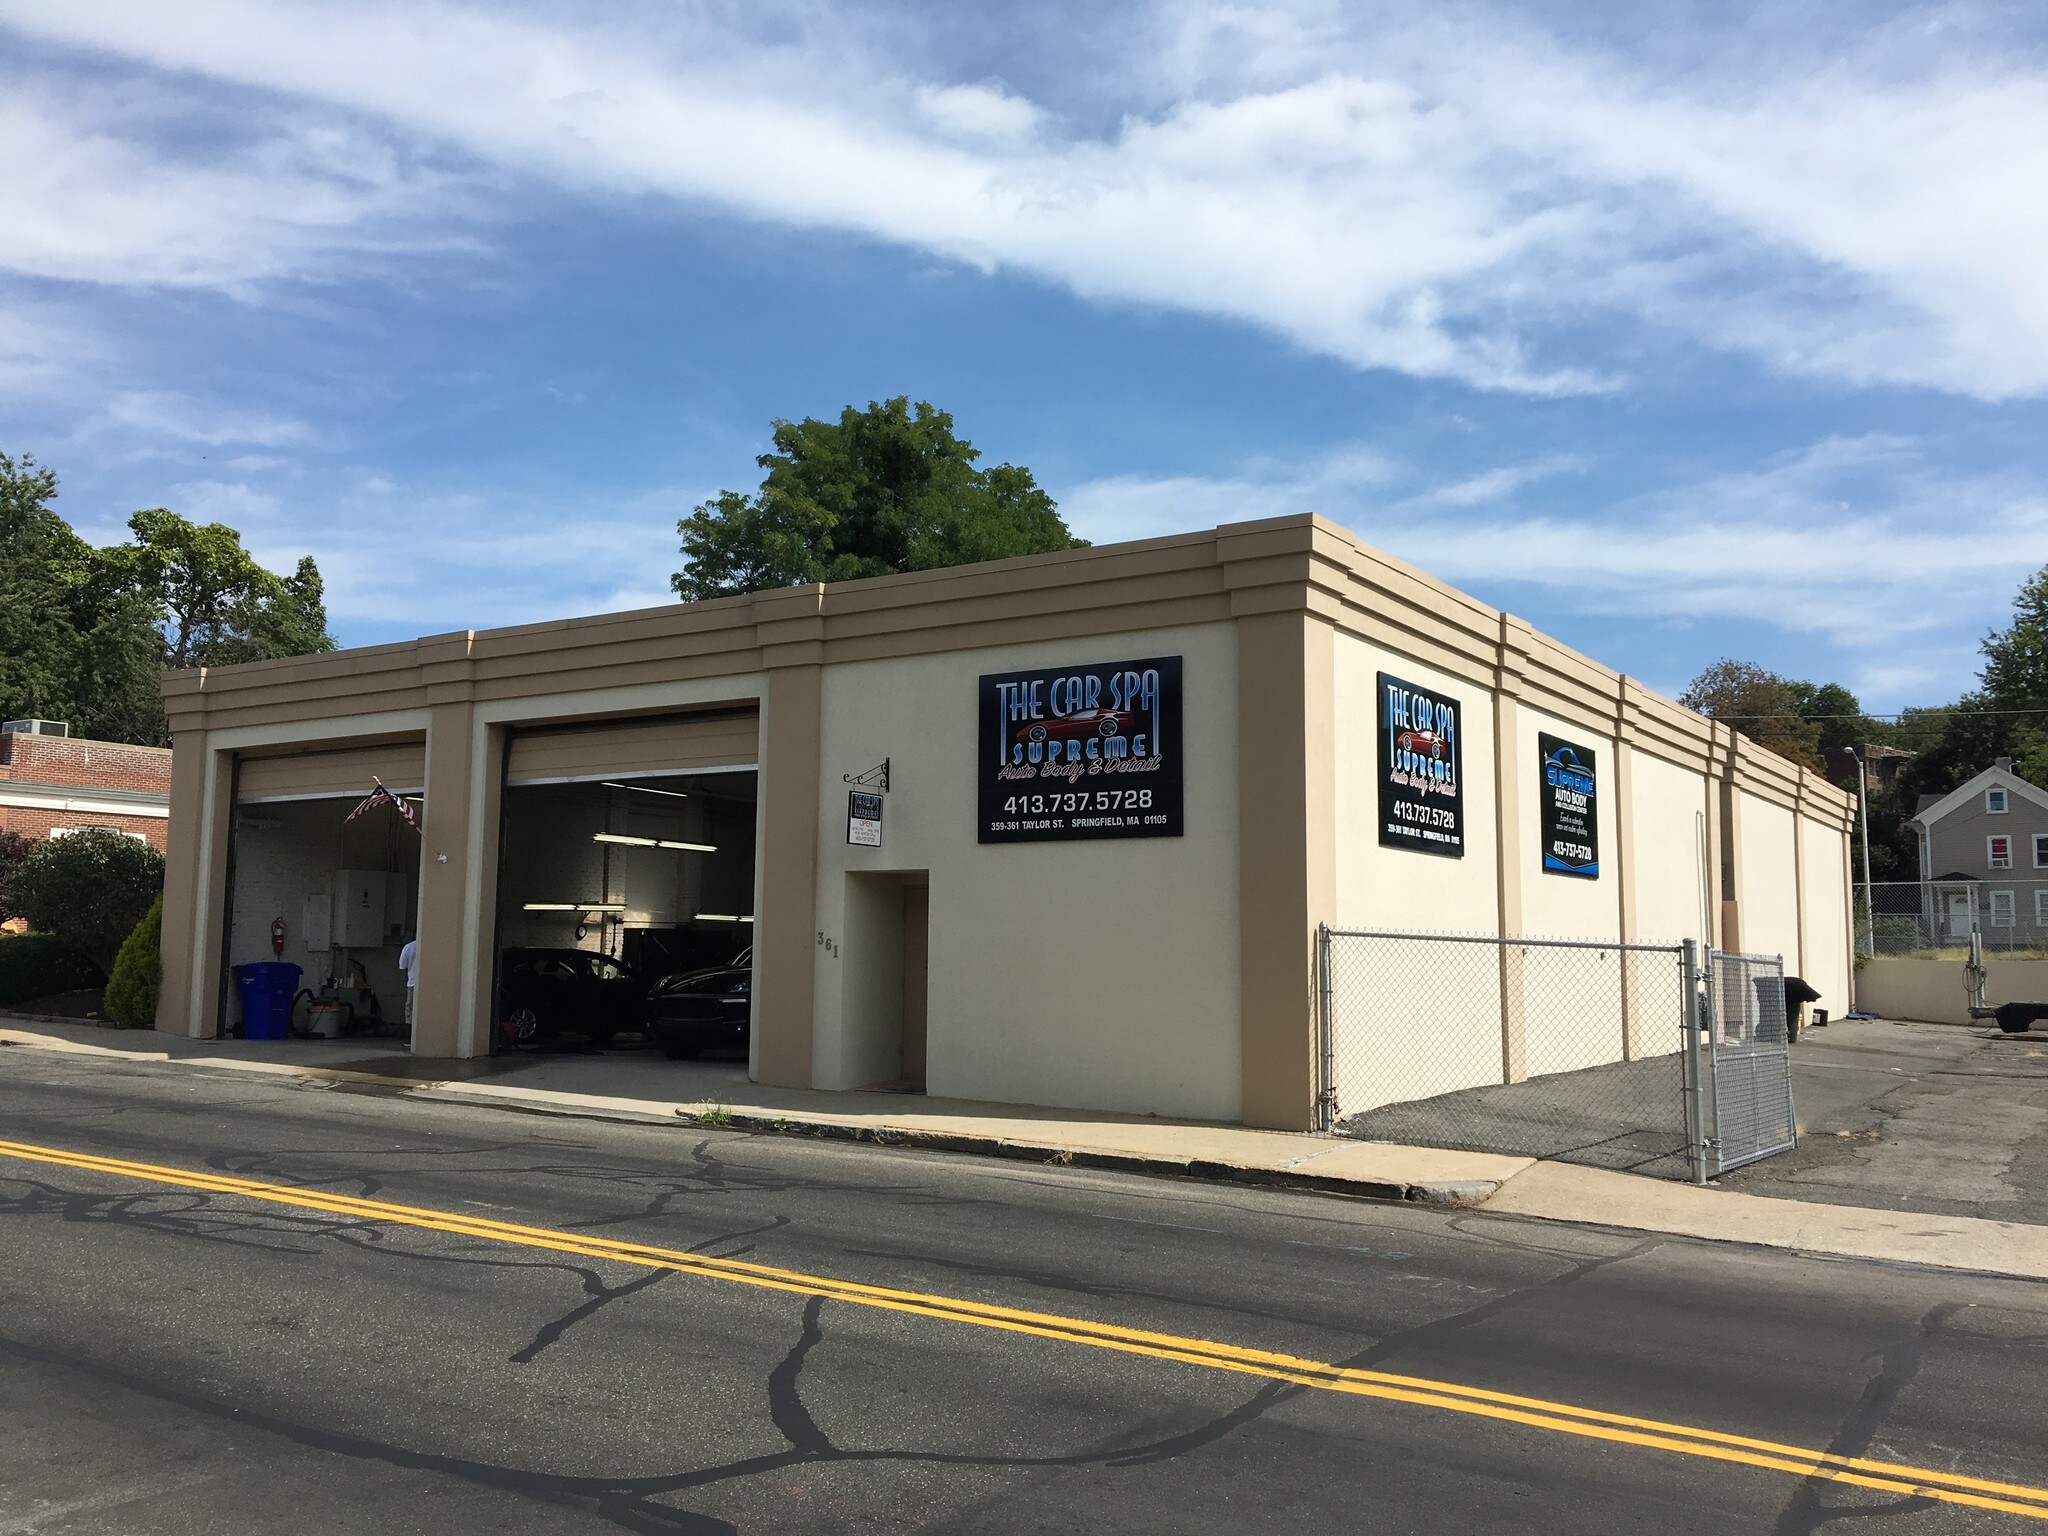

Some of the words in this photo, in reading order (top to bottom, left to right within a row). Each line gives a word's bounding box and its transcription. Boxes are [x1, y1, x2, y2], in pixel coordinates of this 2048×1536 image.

[1051, 675, 1101, 718] CAR
[1411, 693, 1433, 731] CAR
[1013, 734, 1146, 765] SUPREME
[998, 763, 1036, 780] Auto
[1041, 760, 1085, 783] Body
[1088, 758, 1102, 775] &
[1104, 754, 1162, 773] Detail
[1390, 767, 1408, 785] Auto
[1397, 748, 1451, 783] SUPREME
[1547, 766, 1594, 797] SUPREME
[1004, 789, 1152, 814] 413.737.5728
[1555, 788, 1571, 803] AUTO
[1571, 792, 1587, 807] BODY
[991, 821, 1019, 831] 359-361
[1022, 820, 1050, 829] TAYLOR
[1052, 819, 1064, 829] ST.
[1071, 817, 1124, 828] SPRINGFIELD,
[1127, 816, 1140, 825] MA
[1144, 815, 1167, 825] 01105
[1393, 800, 1454, 829] 413.737.5728
[1553, 840, 1592, 860] 413-737-5728
[818, 932, 839, 958] 361
